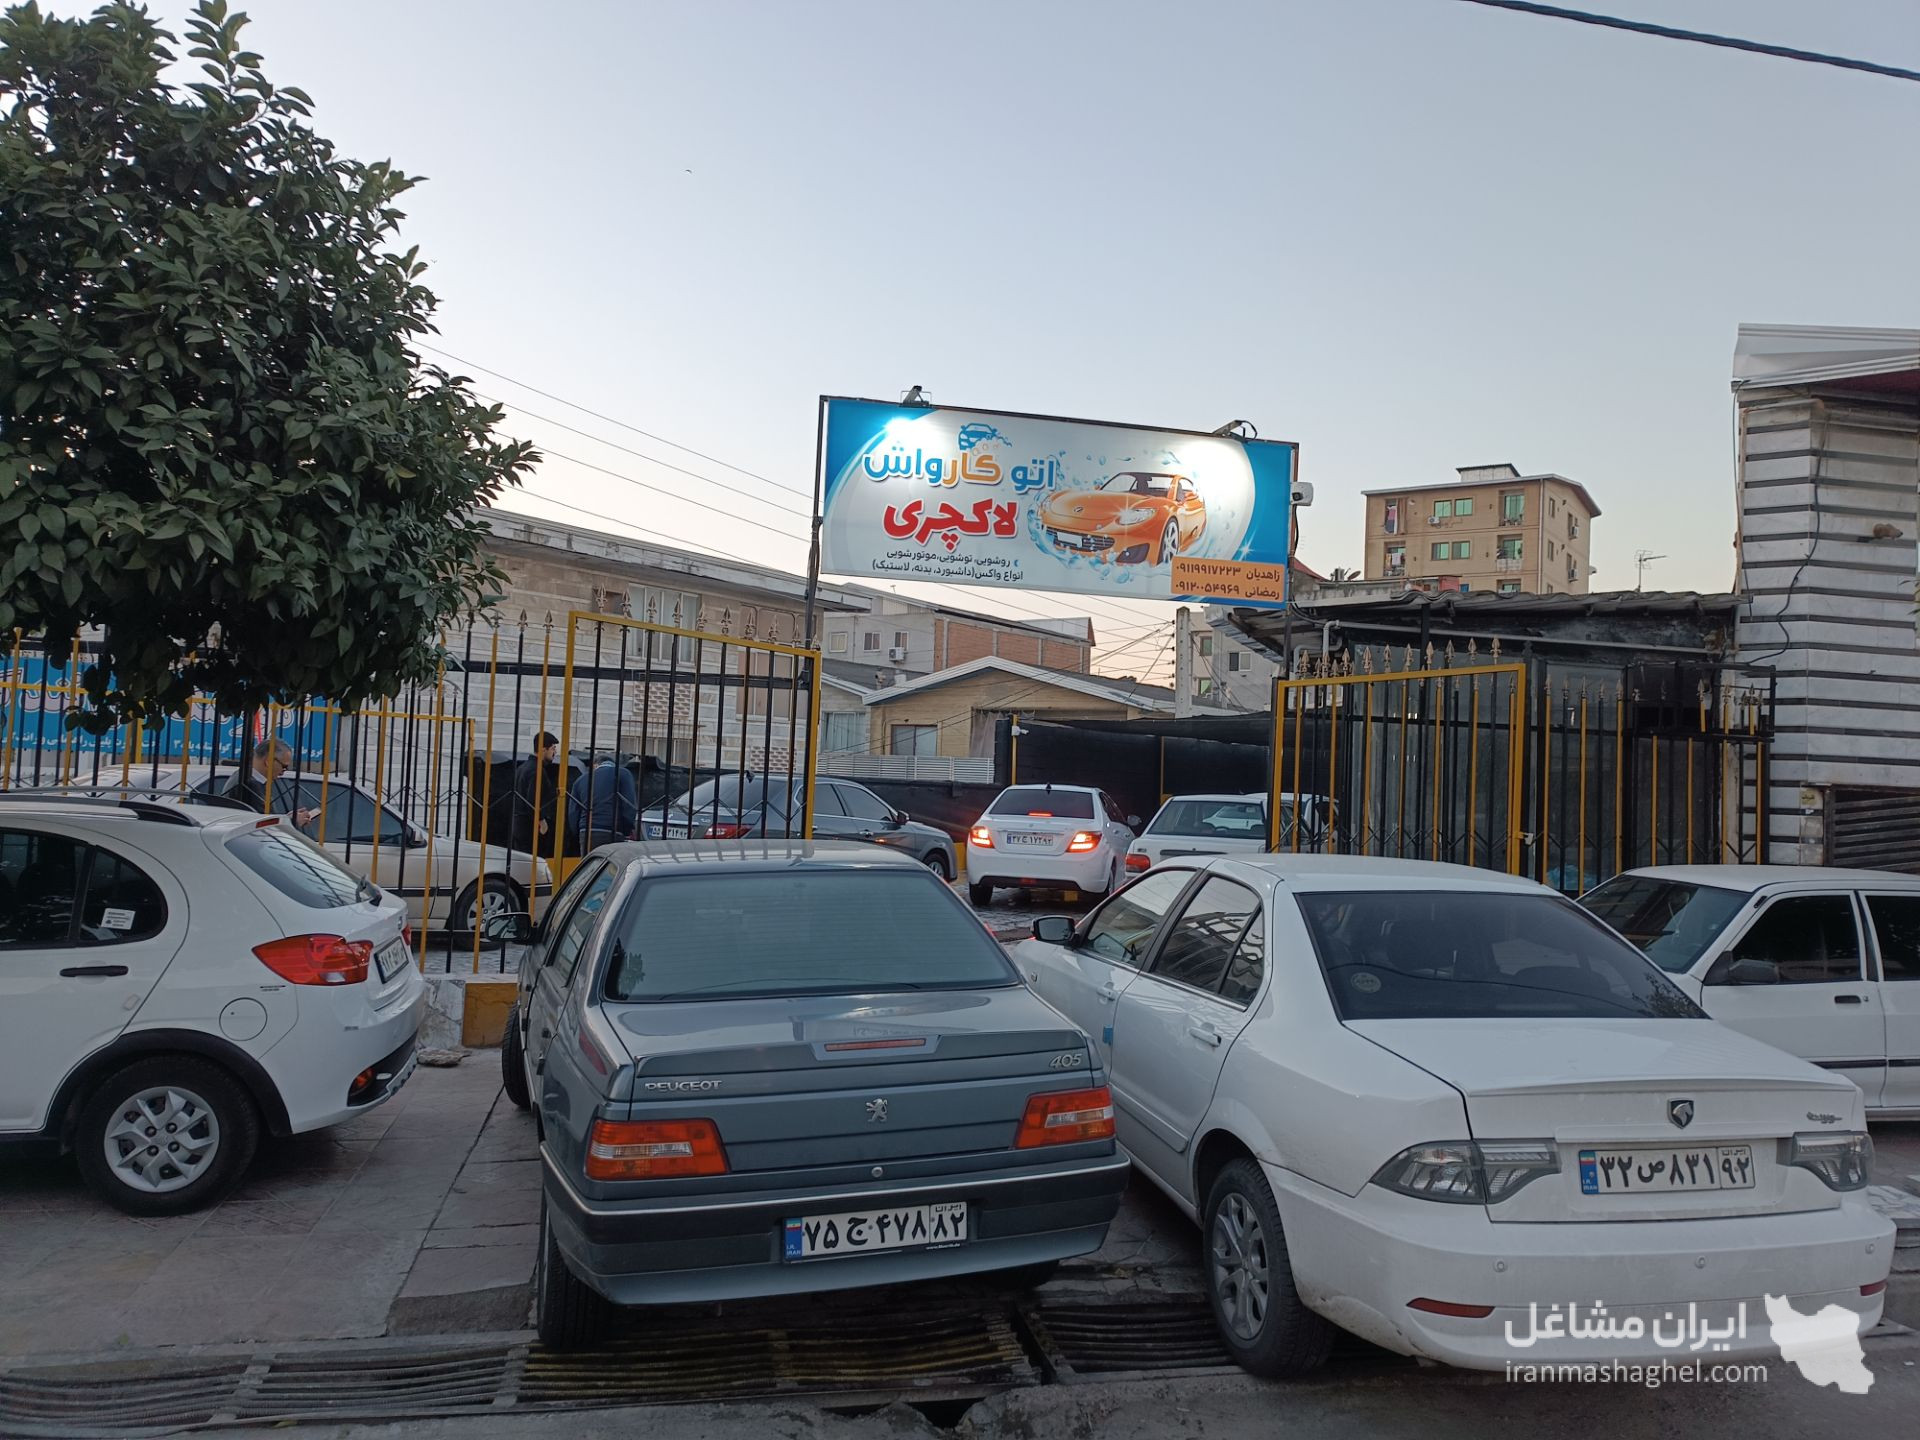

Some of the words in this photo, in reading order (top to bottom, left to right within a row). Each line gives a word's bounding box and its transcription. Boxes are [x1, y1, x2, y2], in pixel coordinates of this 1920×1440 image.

[864, 445, 1001, 486] کارواش
[1012, 458, 1055, 492] اتو
[884, 499, 1018, 551] لاکچری
[1003, 569, 1024, 582] انواع
[1176, 563, 1241, 577] ۰۹۱۱۹۹۱۷۲۲۳
[1246, 568, 1280, 582] زاهدیان
[1175, 580, 1240, 595] ۰۹۱۲۰۰۵۴۹۶۹
[1245, 586, 1280, 600] رمضانی
[1050, 1053, 1082, 1069] 405
[645, 1081, 722, 1092] PEUGEOT
